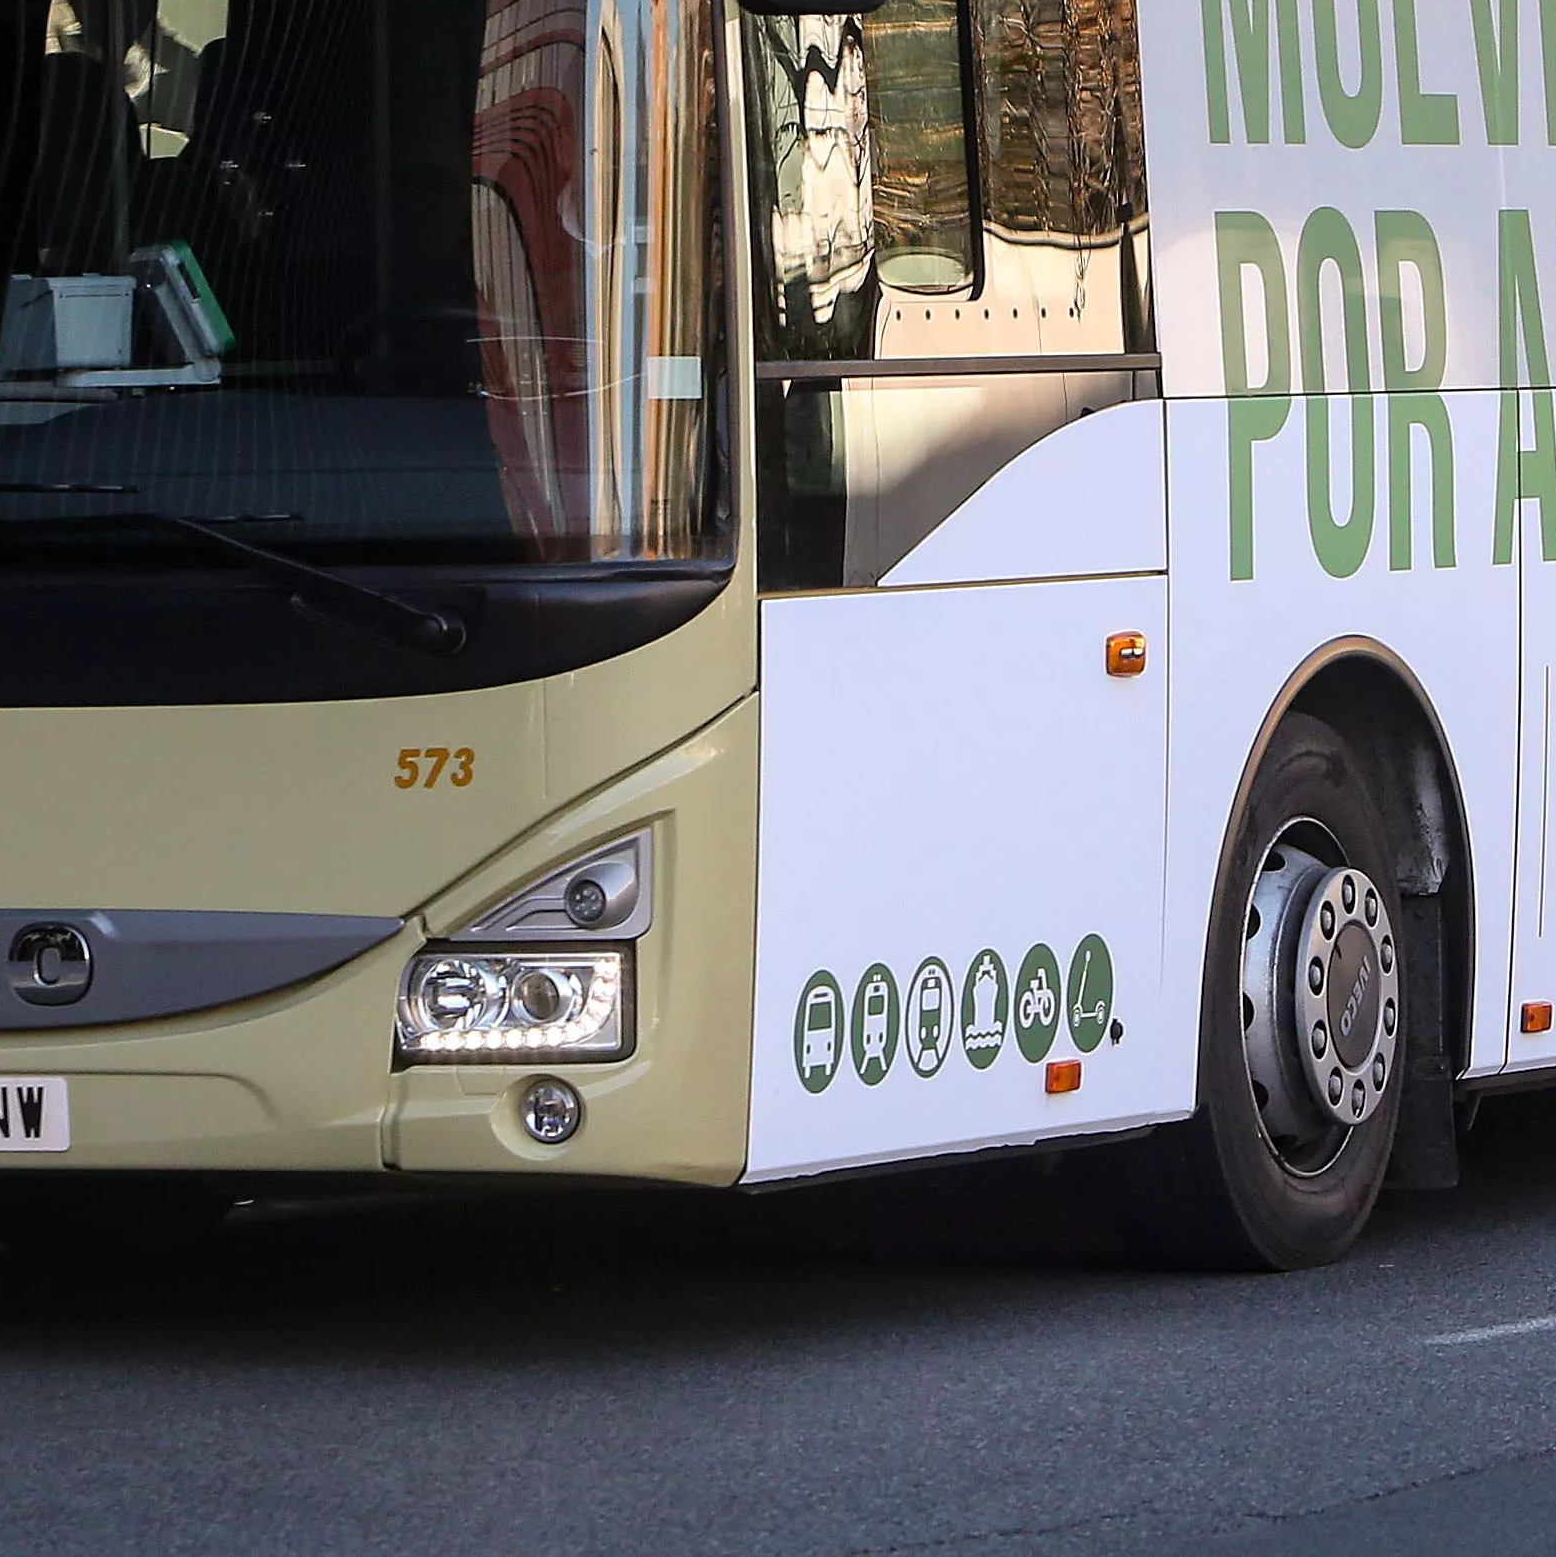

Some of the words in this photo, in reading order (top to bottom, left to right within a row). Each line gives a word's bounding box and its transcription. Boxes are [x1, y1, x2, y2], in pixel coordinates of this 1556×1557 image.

[1213, 205, 1457, 581] POR
[394, 747, 475, 789] 573
[1340, 954, 1372, 1037] IVECO
